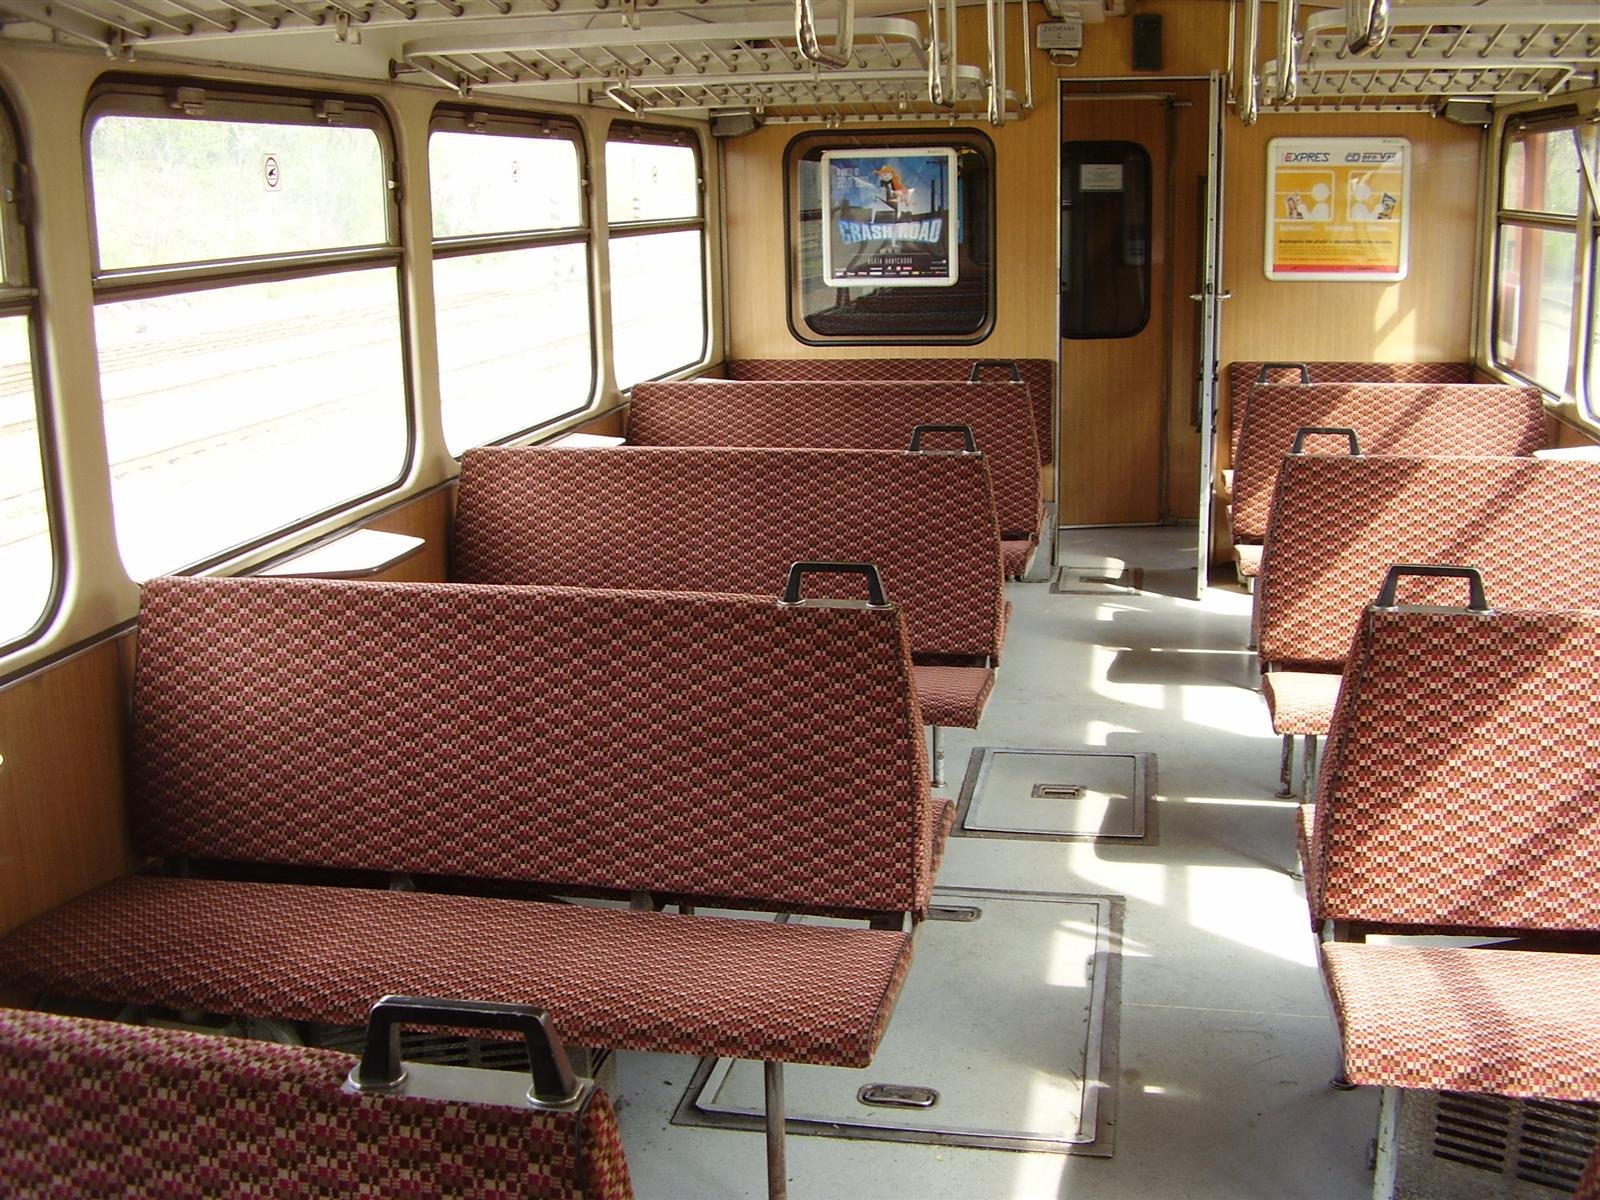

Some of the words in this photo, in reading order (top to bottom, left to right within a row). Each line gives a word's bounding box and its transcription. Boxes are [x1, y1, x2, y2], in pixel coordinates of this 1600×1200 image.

[1284, 152, 1331, 162] EXPRES
[838, 220, 893, 244] CRASH
[895, 219, 942, 243] ROAD
